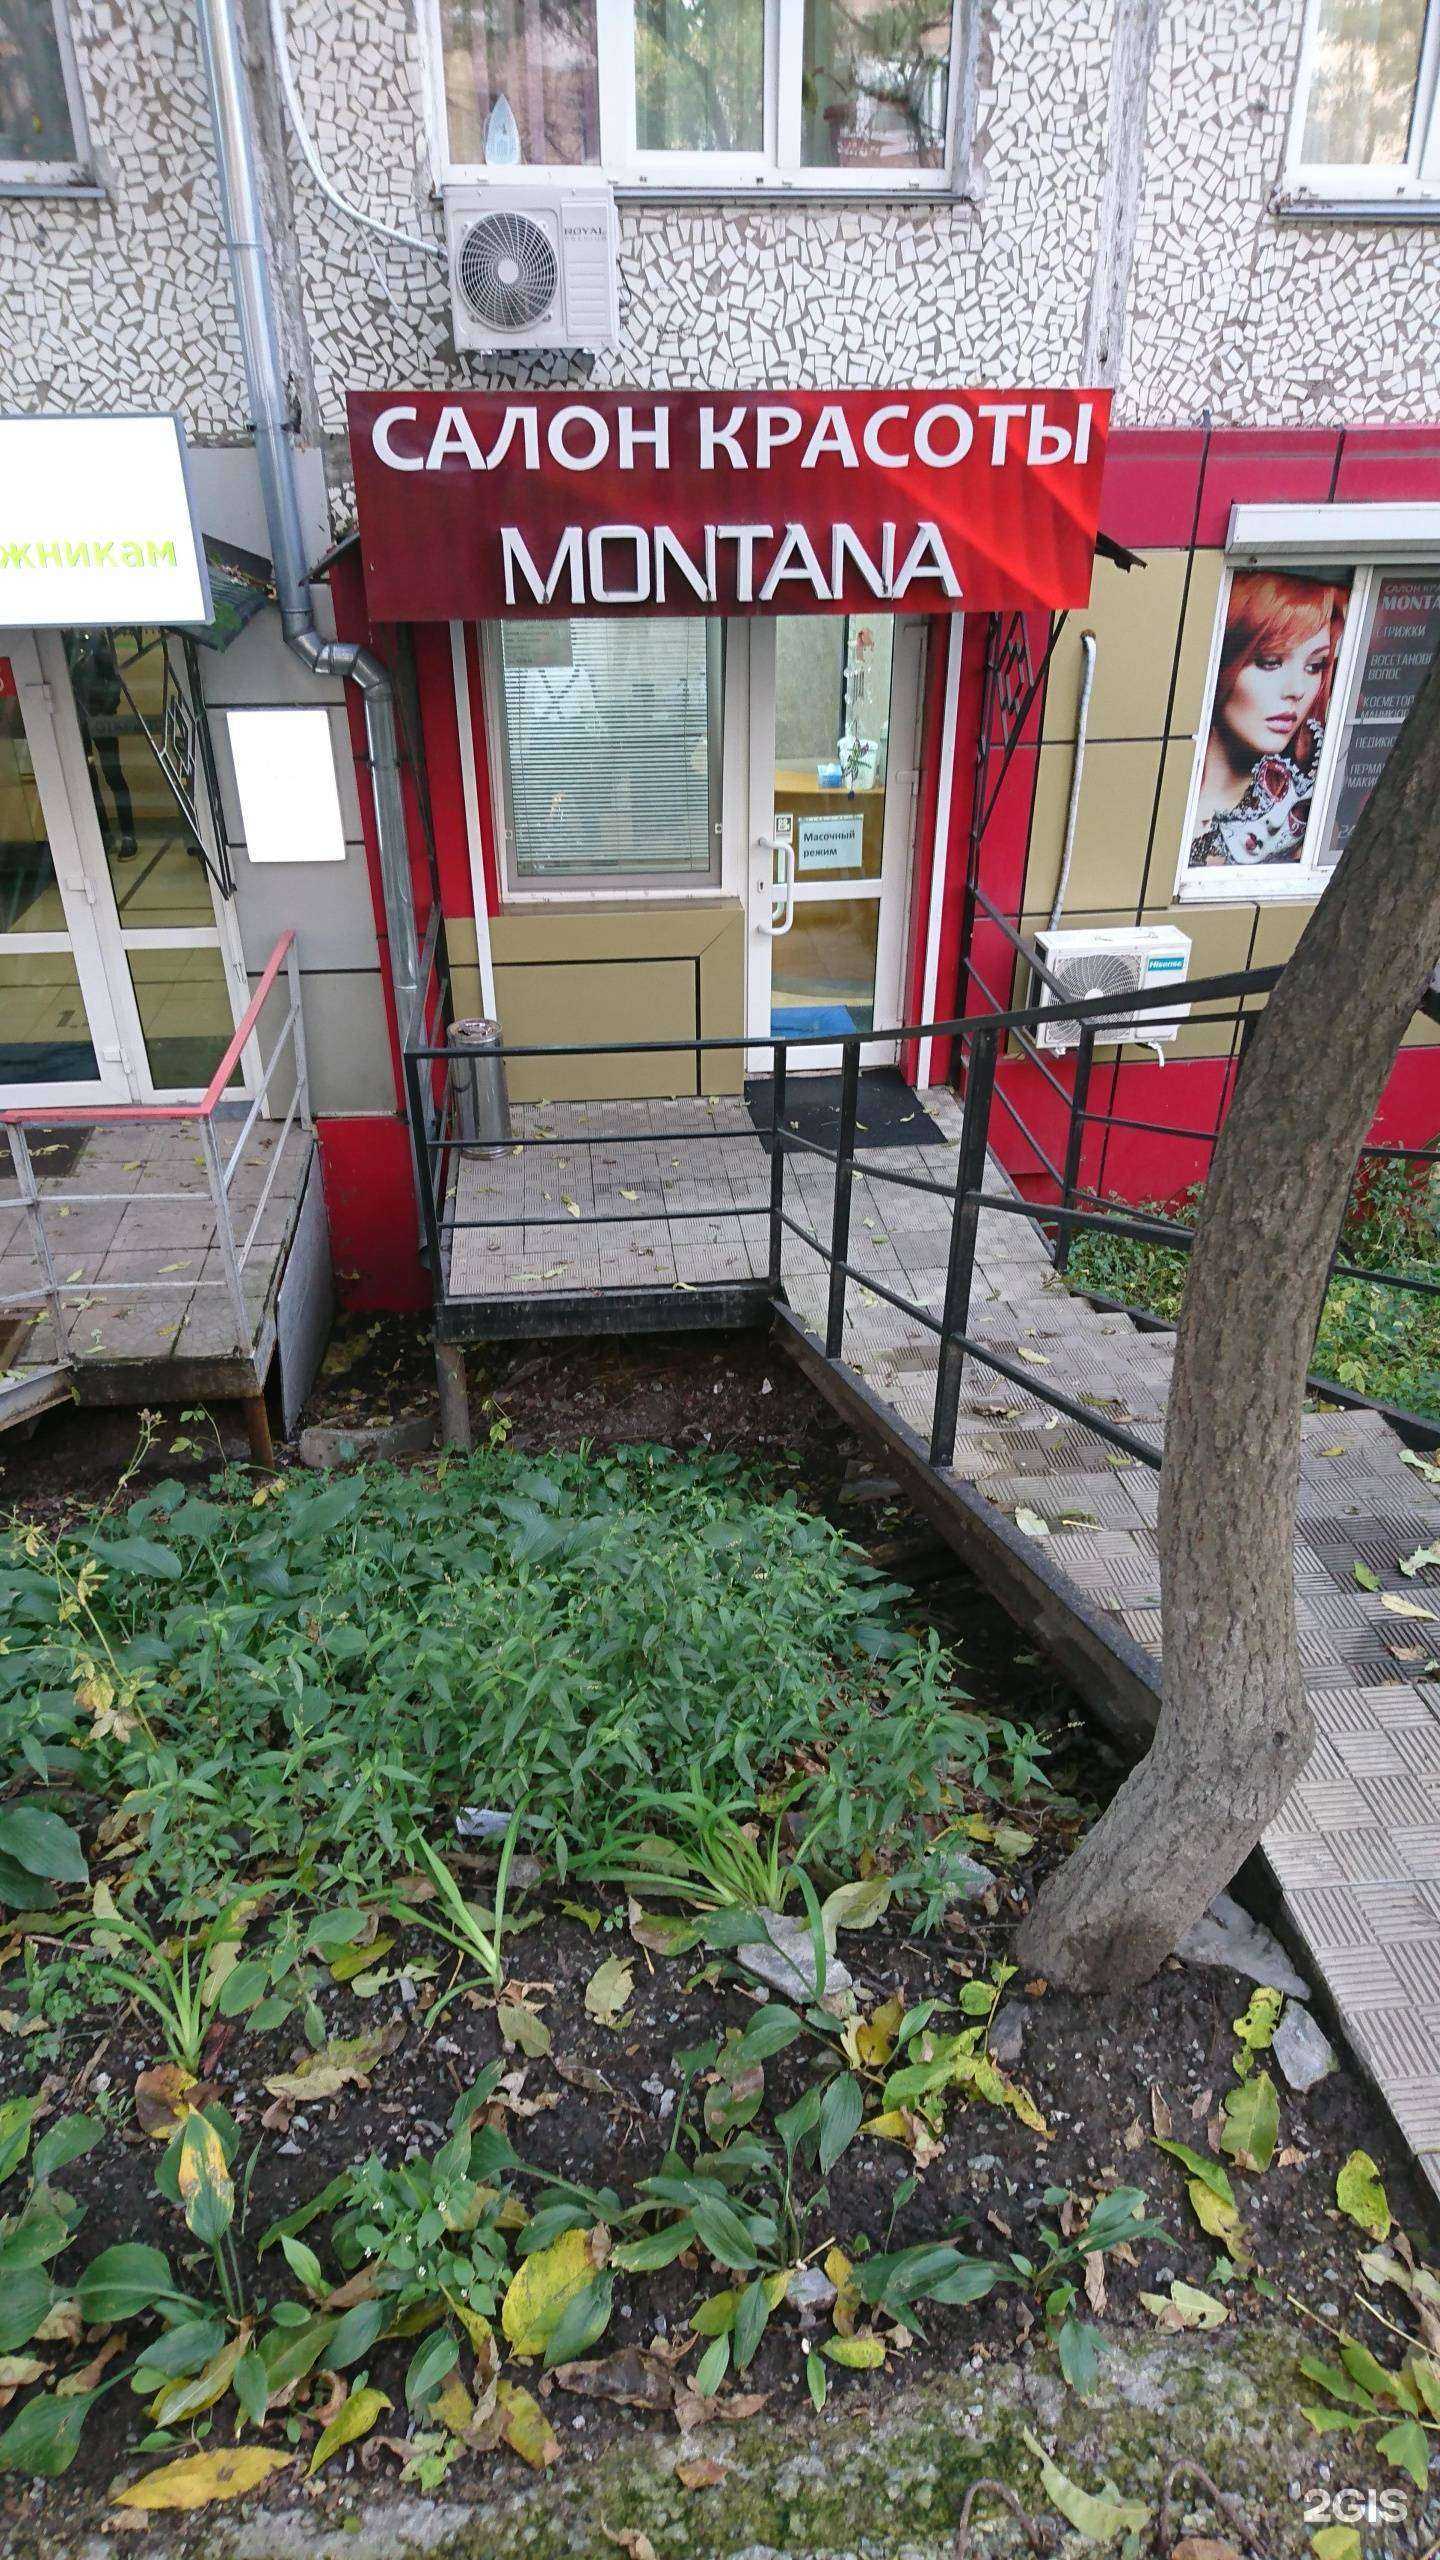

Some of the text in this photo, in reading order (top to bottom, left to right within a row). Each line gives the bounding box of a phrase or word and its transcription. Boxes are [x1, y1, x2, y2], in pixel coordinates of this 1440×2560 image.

[372, 403, 1094, 471] САЛОН КРАСОТЫ
[500, 521, 964, 605] MONTANA
[802, 848, 838, 859] режим
[803, 829, 856, 843] Масочный
